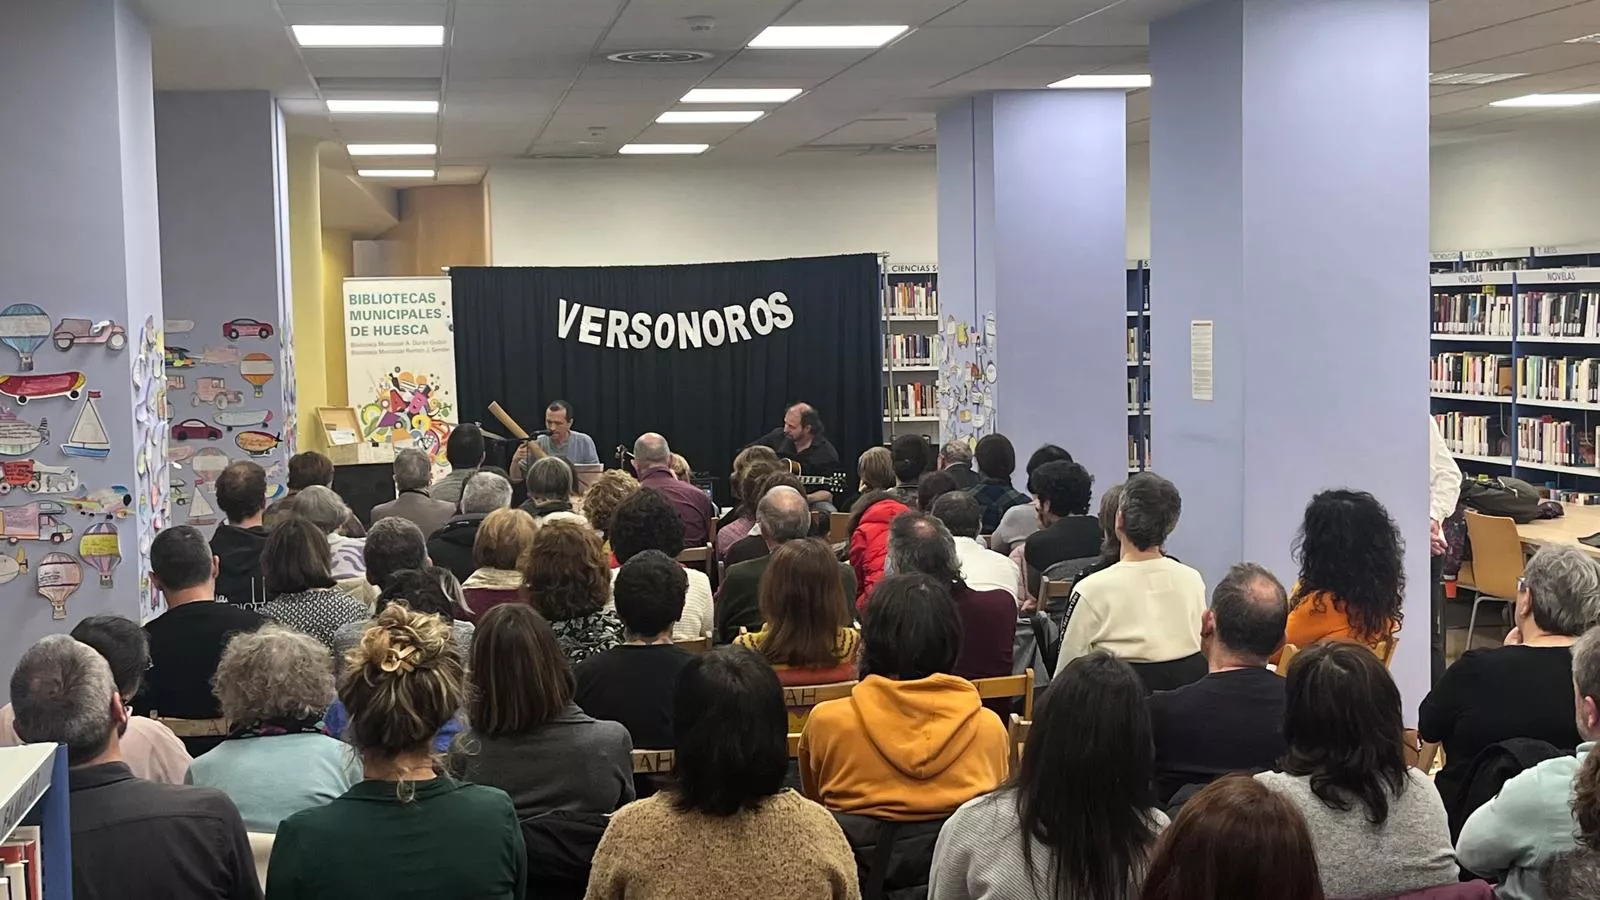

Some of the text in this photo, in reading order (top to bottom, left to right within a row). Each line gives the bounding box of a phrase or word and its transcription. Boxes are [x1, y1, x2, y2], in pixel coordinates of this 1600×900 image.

[891, 264, 938, 272] CIENCIAS S
[1458, 274, 1483, 284] NOVELAS
[1547, 271, 1576, 281] NOVELAS
[349, 292, 436, 305] BIBLIOTECAS
[349, 308, 442, 321] MUNICIPALES
[557, 291, 794, 350] VERSONOROS
[350, 324, 429, 337] DE HUESCA
[640, 753, 673, 771] AH
